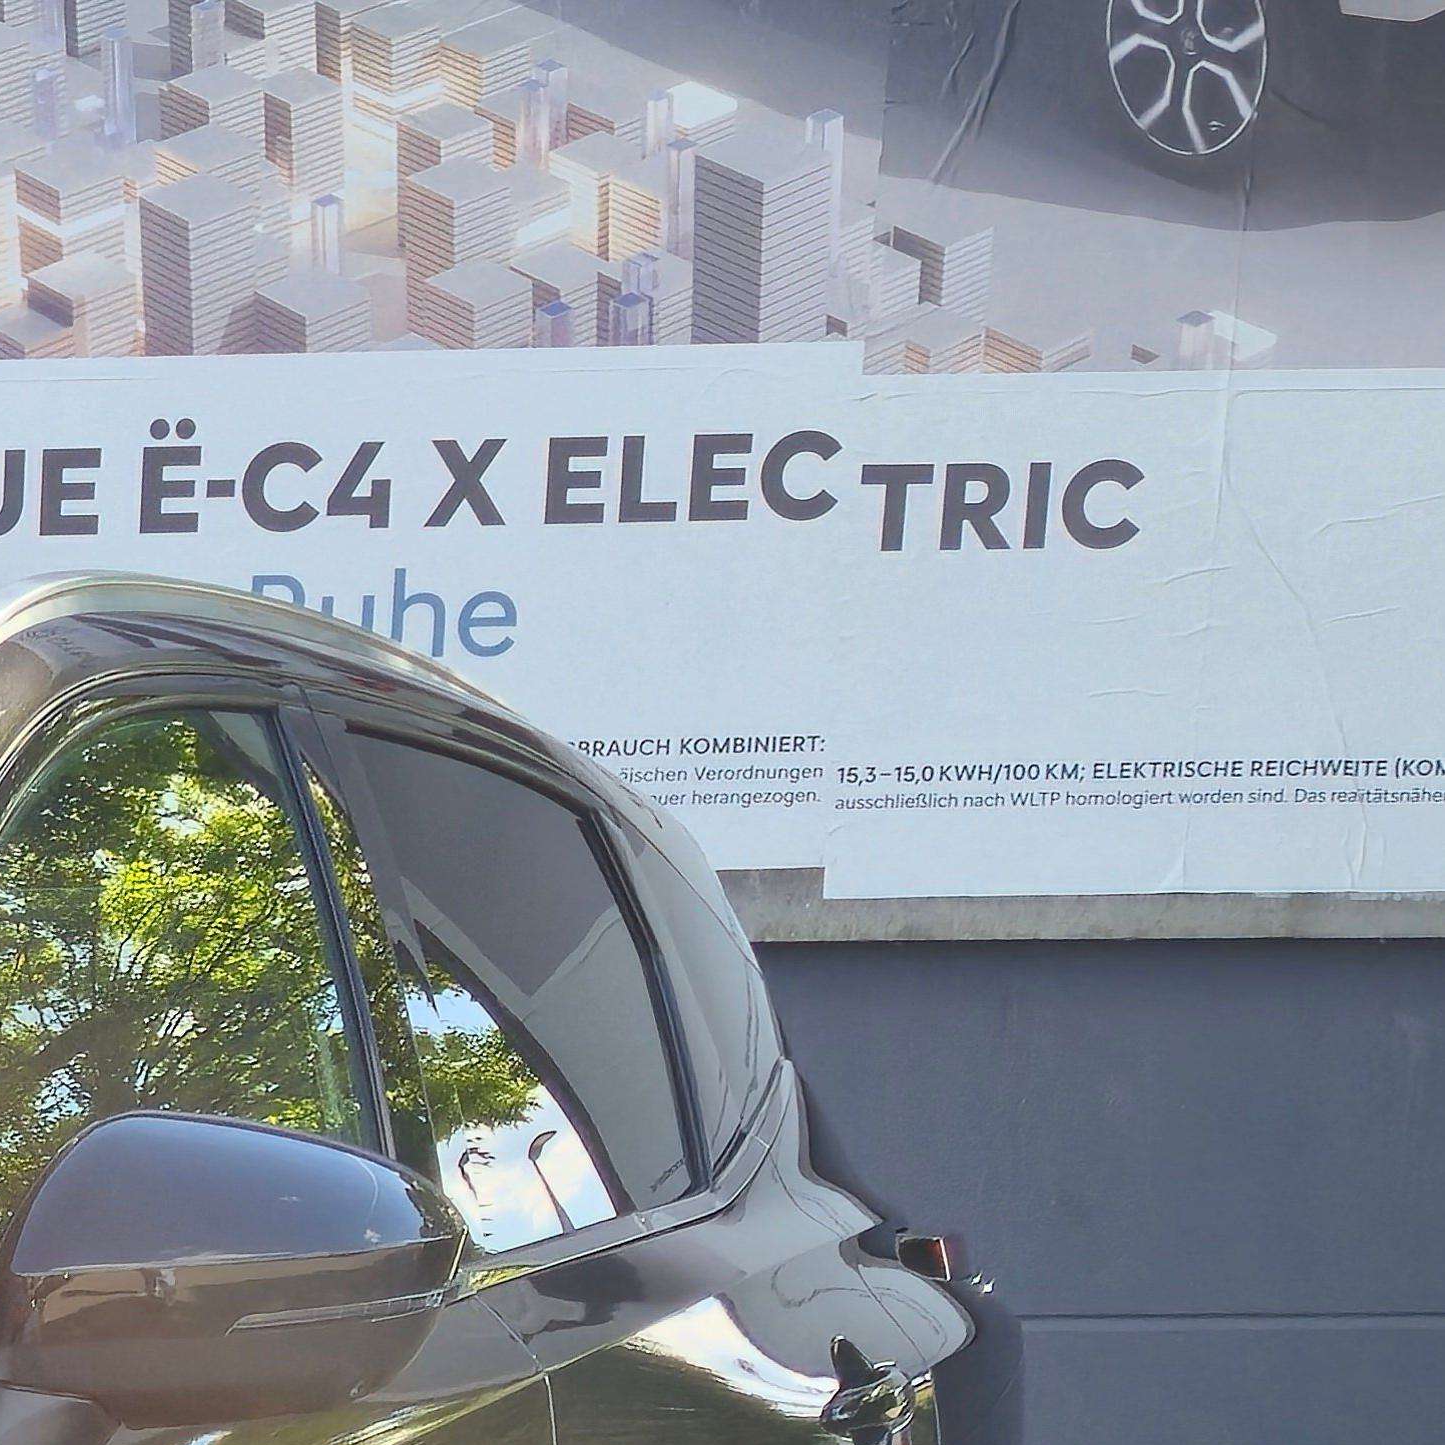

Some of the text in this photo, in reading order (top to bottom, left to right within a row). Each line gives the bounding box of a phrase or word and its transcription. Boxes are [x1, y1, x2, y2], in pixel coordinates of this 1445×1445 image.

[139, 418, 392, 534] Ë-C4
[423, 438, 508, 528] X
[568, 737, 671, 757] BRAUCH
[678, 734, 827, 755] KOMBINIERT:
[1092, 760, 1244, 781] ELEKTRISCHE
[1249, 758, 1389, 778] REICHWEITE
[691, 788, 821, 809] herangezogen.
[694, 764, 824, 784] Verordnungen
[834, 791, 959, 811] ausschließlich
[963, 790, 1005, 808] nach
[1010, 791, 1061, 807] WLTP
[1065, 789, 1173, 810] homologiert
[1178, 788, 1244, 805] worden
[1294, 787, 1327, 804] Das
